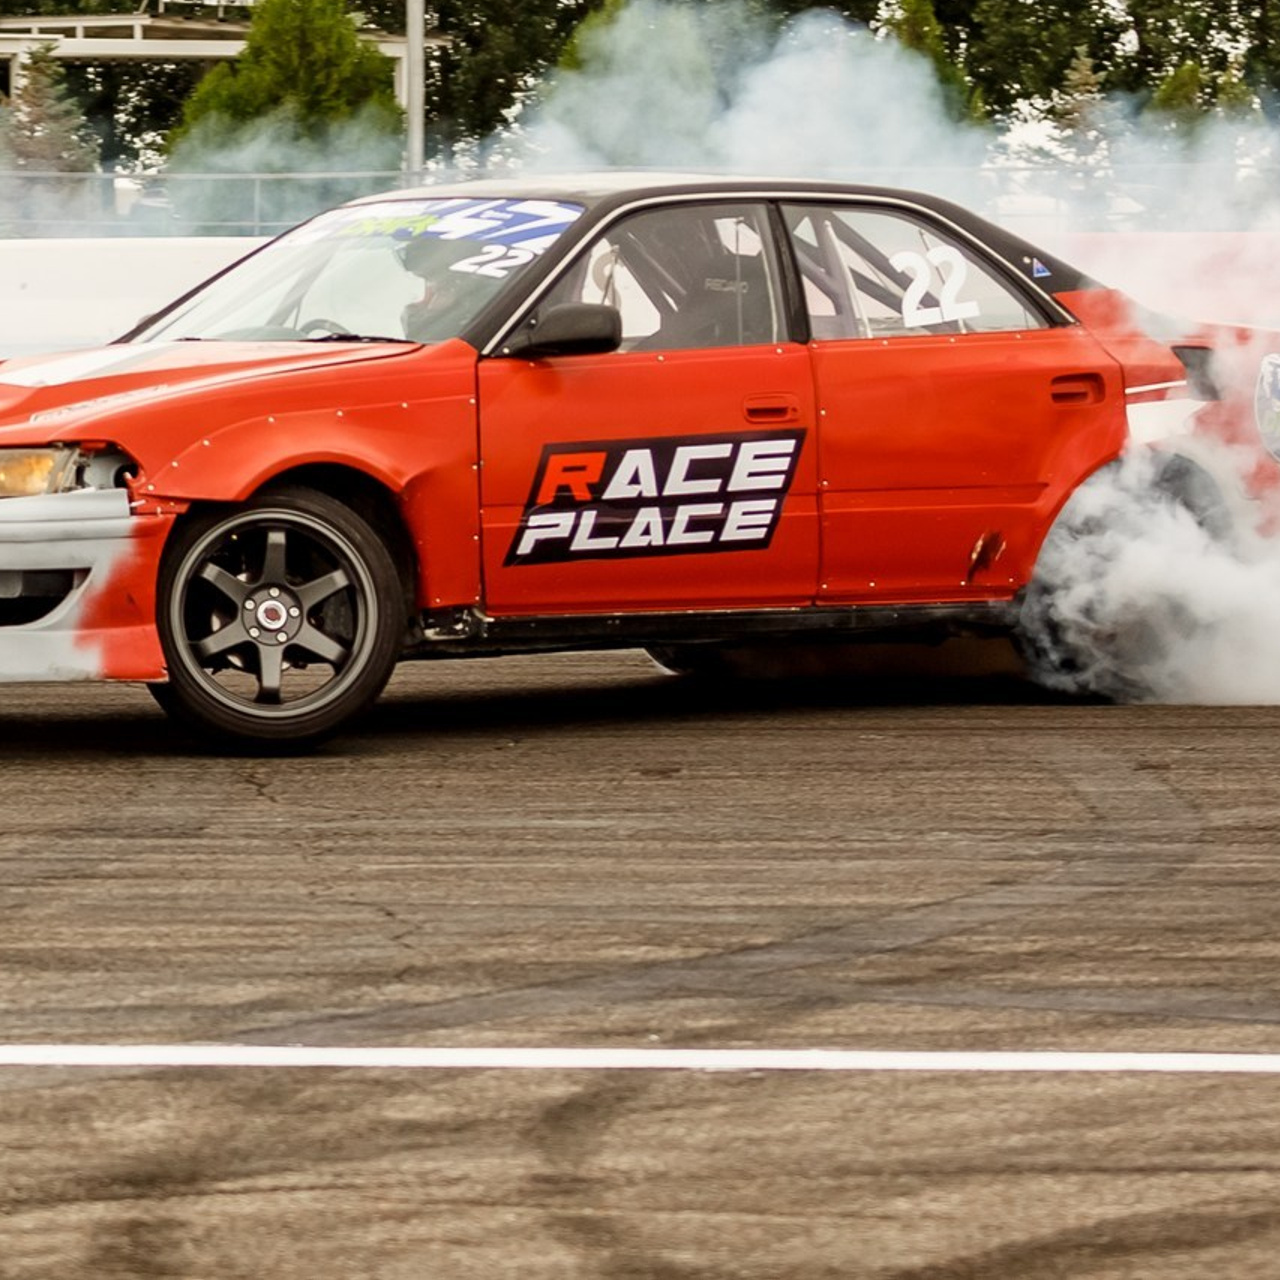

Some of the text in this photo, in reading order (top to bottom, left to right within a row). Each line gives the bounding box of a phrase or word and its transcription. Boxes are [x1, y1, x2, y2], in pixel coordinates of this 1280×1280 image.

[448, 244, 534, 278] 22
[888, 245, 981, 328] 22
[536, 439, 797, 506] RACE
[516, 499, 778, 556] PLACE
